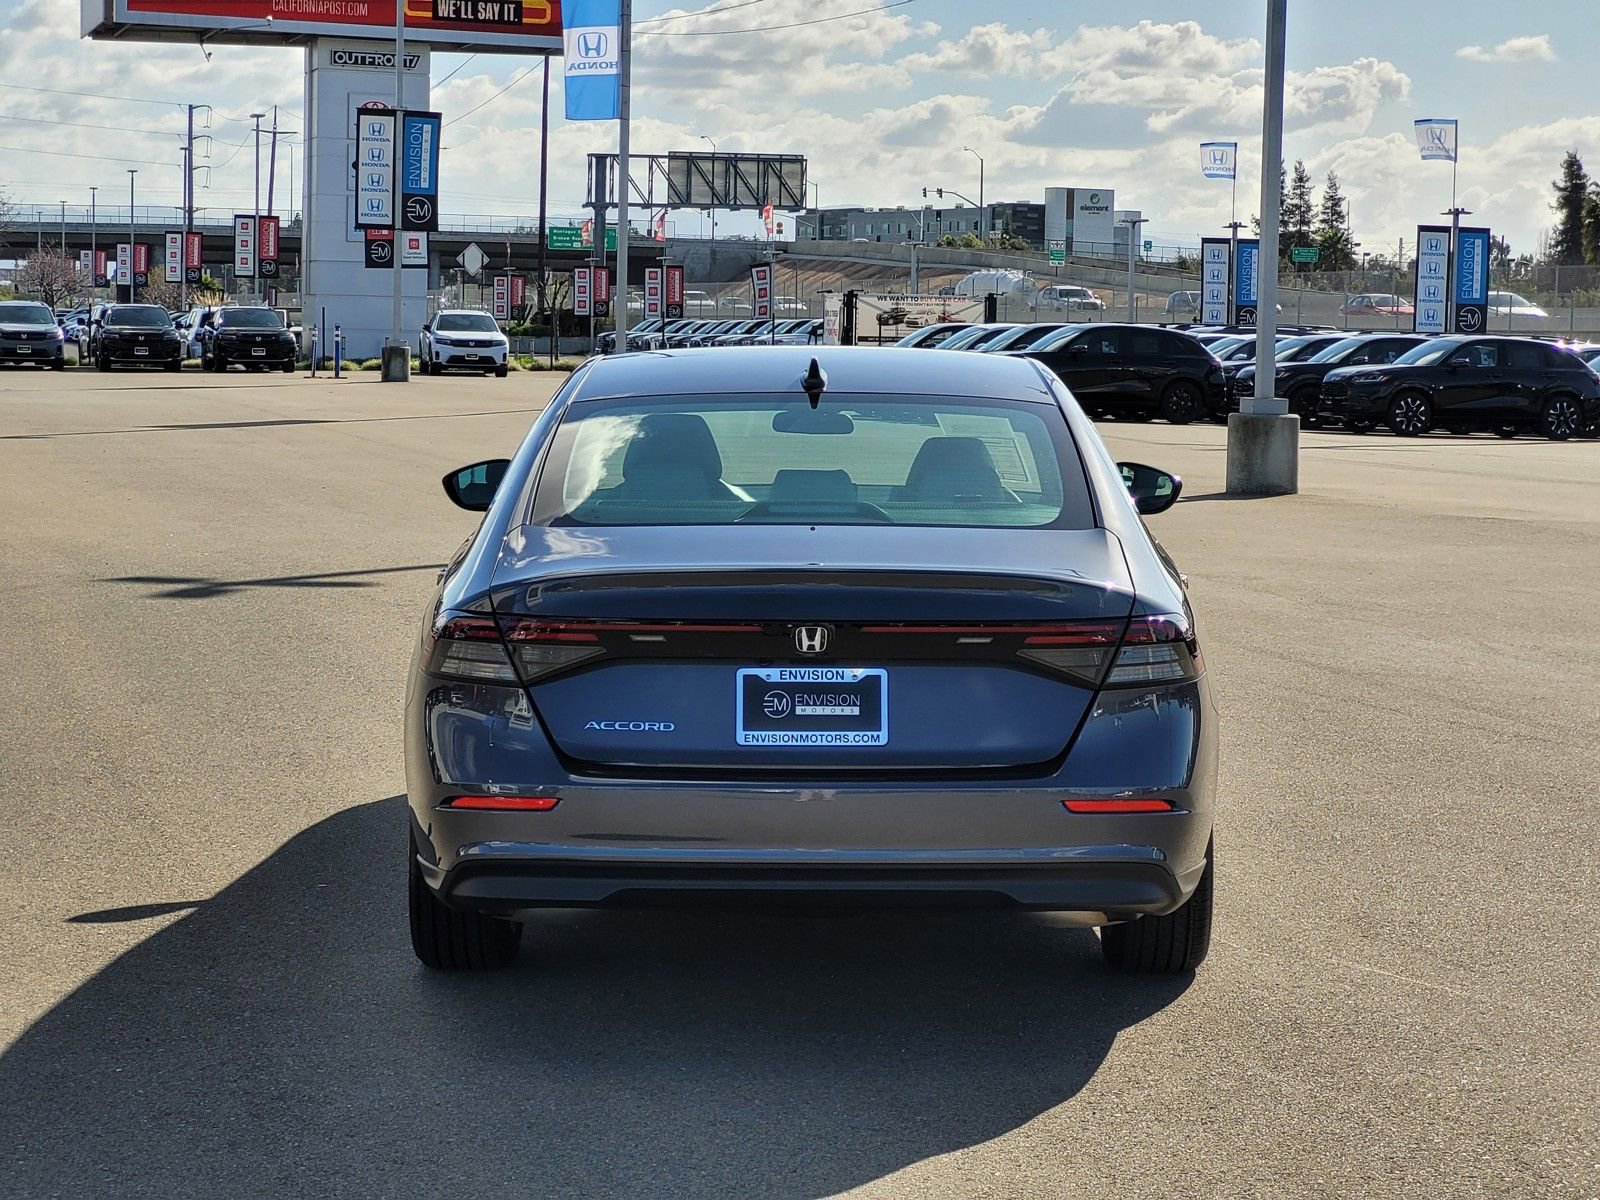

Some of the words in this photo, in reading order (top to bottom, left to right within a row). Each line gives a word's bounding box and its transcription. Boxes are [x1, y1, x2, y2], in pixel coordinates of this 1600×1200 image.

[272, 0, 368, 16] CALIFORNIAPOST.COM
[437, 0, 474, 19] WE'LL
[477, 2, 500, 20] SAY
[504, 4, 518, 22] IT.
[335, 52, 418, 67] OUTFROT/
[408, 122, 424, 188] ENVISION
[422, 129, 430, 183] MOTORS
[1241, 248, 1252, 301] ENVISION
[1461, 238, 1474, 299] ENVISION
[779, 669, 845, 681] ENVISION
[795, 694, 860, 706] ENVISION
[584, 721, 675, 731] ACCORD
[744, 733, 881, 744] ENVISIONMOTORS.COM
